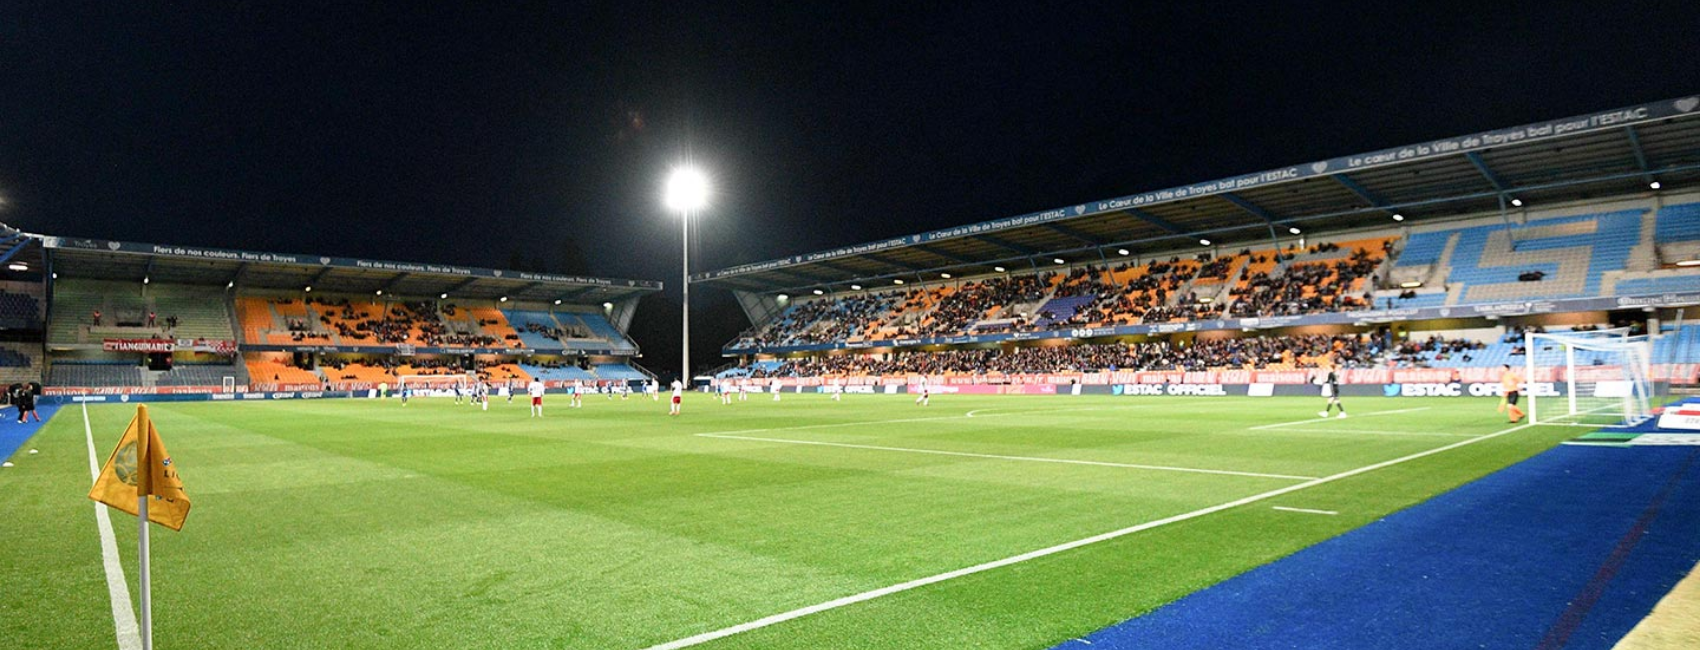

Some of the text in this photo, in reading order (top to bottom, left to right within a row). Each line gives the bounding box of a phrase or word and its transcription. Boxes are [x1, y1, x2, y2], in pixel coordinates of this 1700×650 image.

[1348, 157, 1361, 168] Le
[1398, 146, 1415, 159] de
[1416, 143, 1430, 156] la
[1432, 138, 1458, 153] Ville
[1462, 134, 1480, 148] de
[1482, 129, 1525, 146] Troyes
[1527, 124, 1552, 138] bat
[1554, 119, 1588, 136] pour
[1591, 107, 1647, 127] l'ESTAC
[1098, 202, 1107, 211] Le
[1132, 195, 1144, 205] de
[1145, 193, 1154, 203] la
[1155, 189, 1173, 201] Ville
[1175, 187, 1187, 197] de
[1188, 183, 1217, 196] Troyes
[1218, 179, 1236, 190] bat
[1236, 176, 1259, 188] pour
[1261, 168, 1298, 183] l'ESTAC
[968, 225, 981, 233] Ville
[982, 223, 991, 231] de
[991, 221, 1011, 230] Troyes
[1012, 217, 1023, 225] bat
[1024, 215, 1039, 224] pour
[154, 245, 172, 254] Fiers
[174, 247, 185, 255] de
[241, 252, 259, 260] Fiers
[260, 253, 271, 261] de
[272, 254, 297, 263] Troyes
[357, 260, 372, 268] Fiers
[374, 261, 383, 269] de
[427, 265, 441, 273] Fiers
[452, 267, 471, 275] Troyes
[1124, 384, 1227, 395] ESTAC OFFICIEL
[1401, 382, 1461, 396] ESTAC
